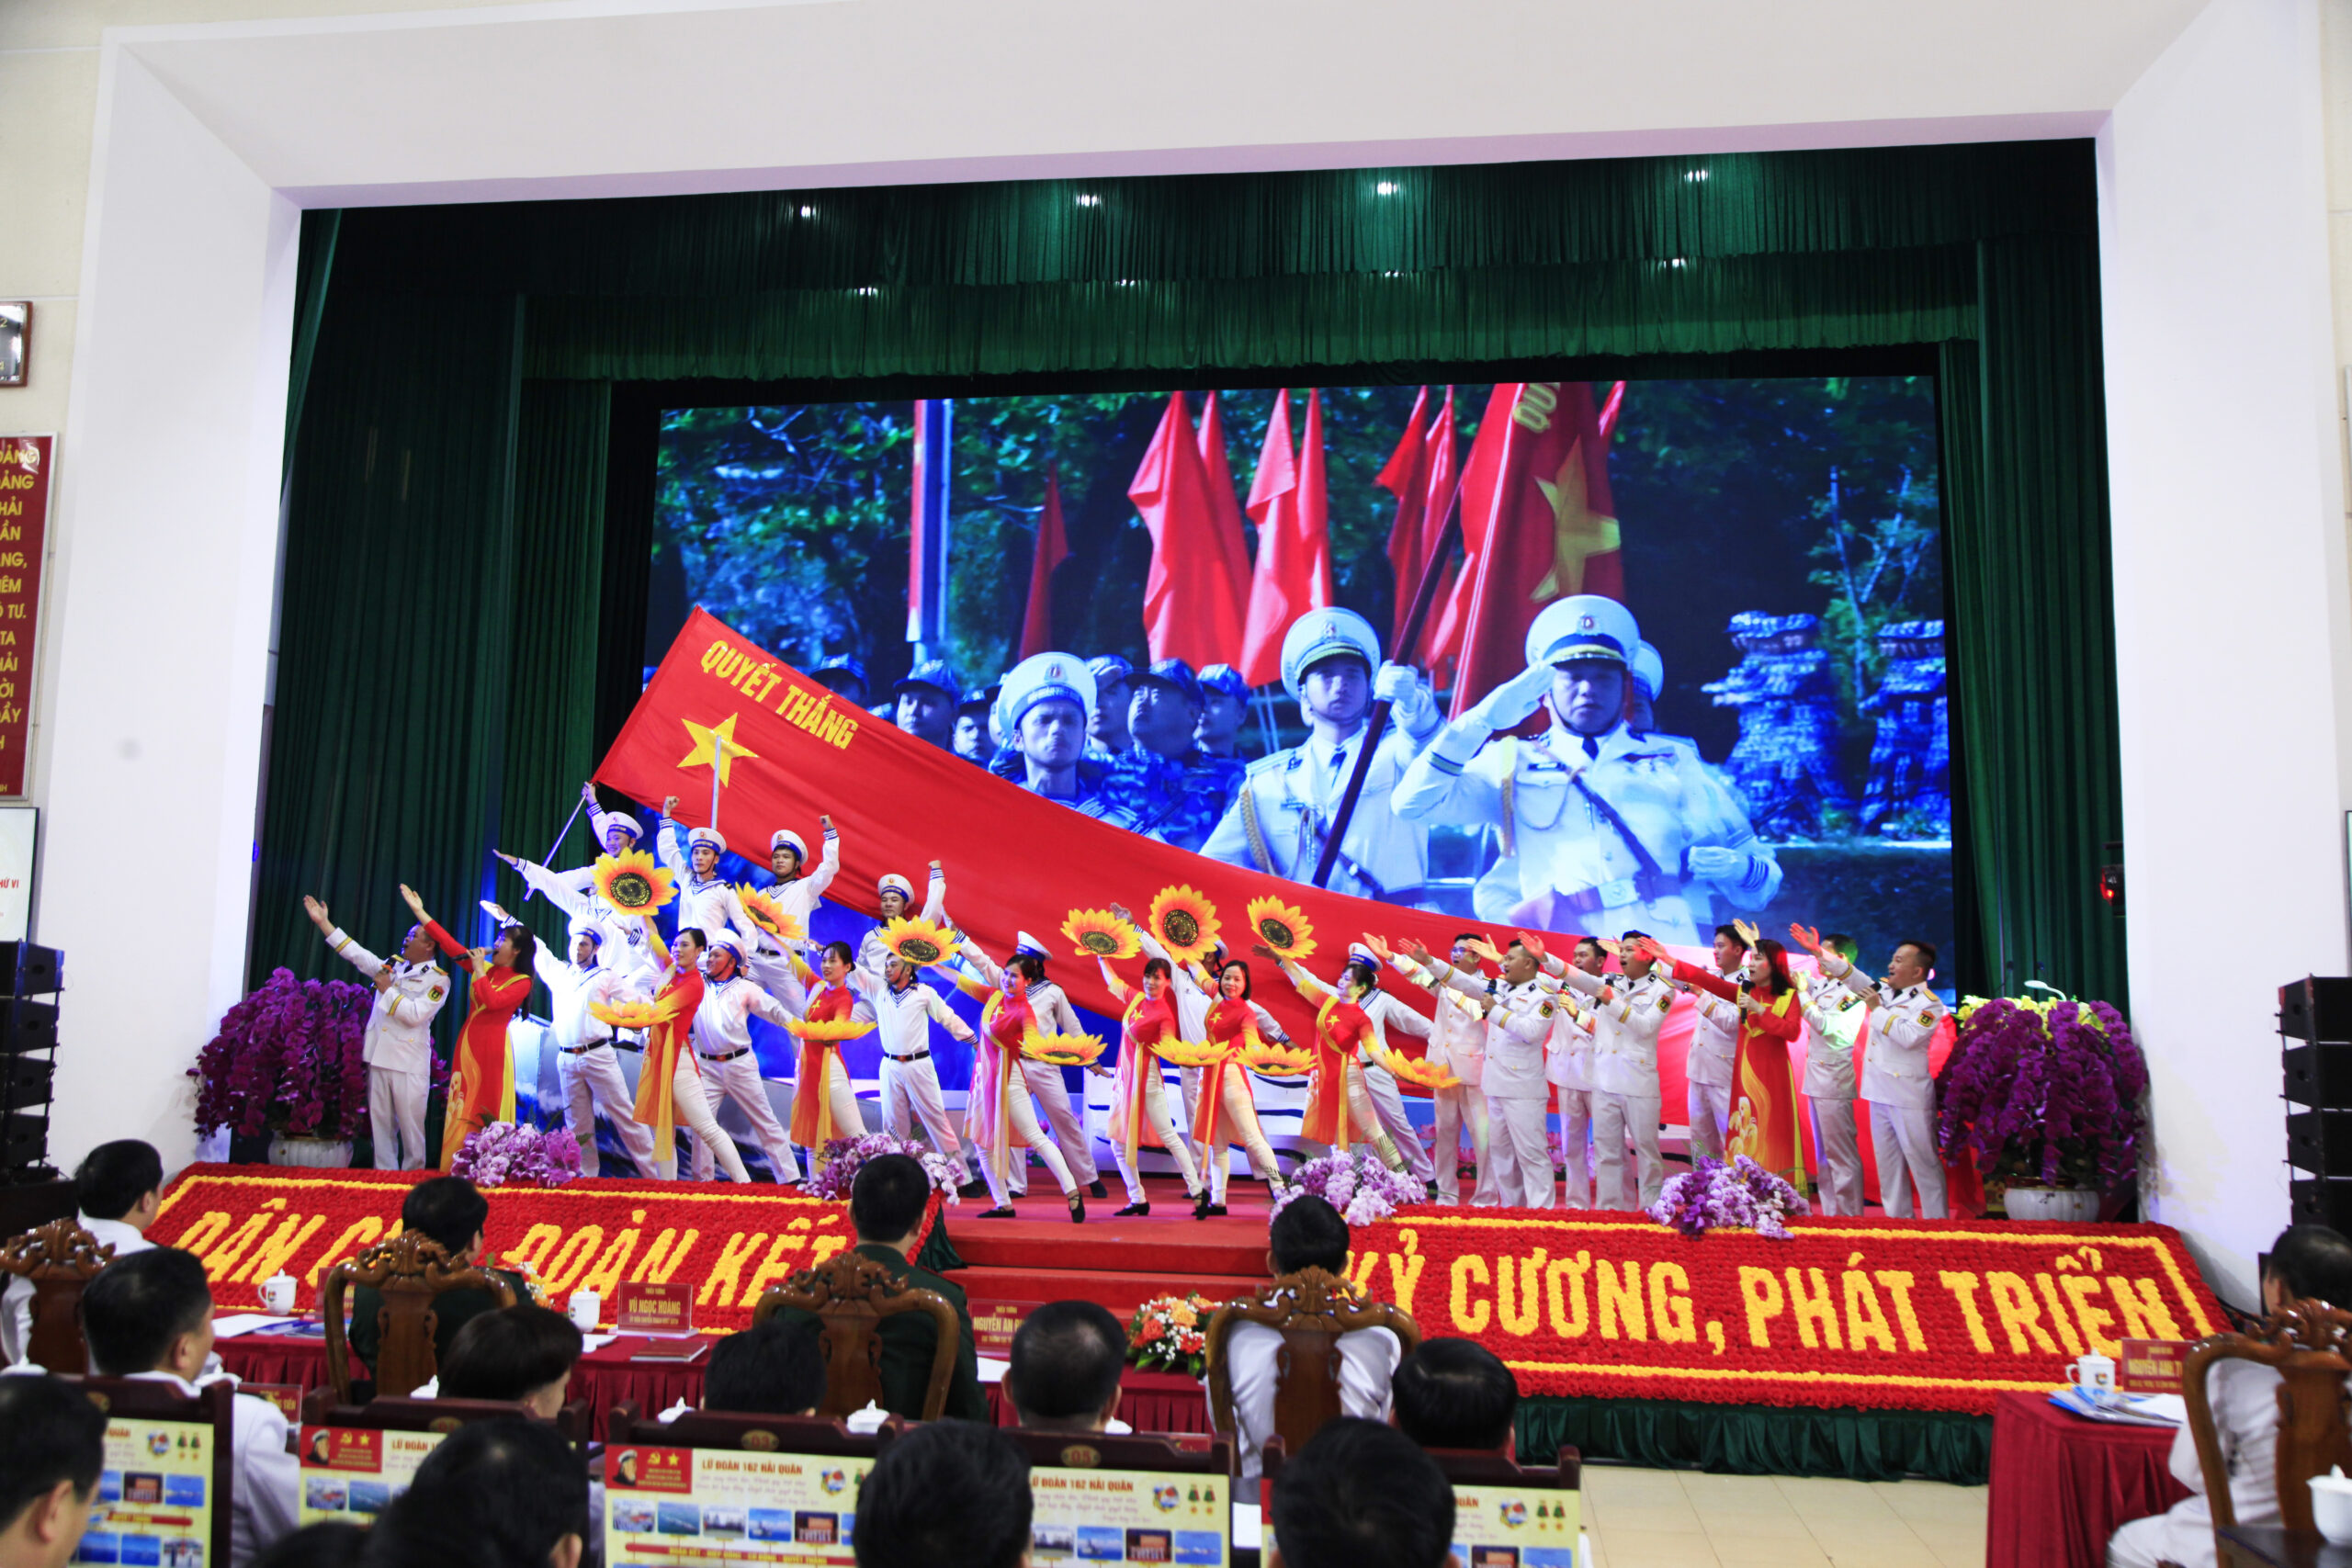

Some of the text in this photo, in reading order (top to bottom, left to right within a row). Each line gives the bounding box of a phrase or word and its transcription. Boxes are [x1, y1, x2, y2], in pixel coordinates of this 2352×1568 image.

[0, 469, 34, 490] ẢNG
[700, 640, 859, 750] QUYẾT THẮNG
[502, 1209, 699, 1301] ĐOÀN
[1450, 1247, 1725, 1356] CƯƠNG,
[1737, 1246, 2184, 1358] PHÁT TRIỂN
